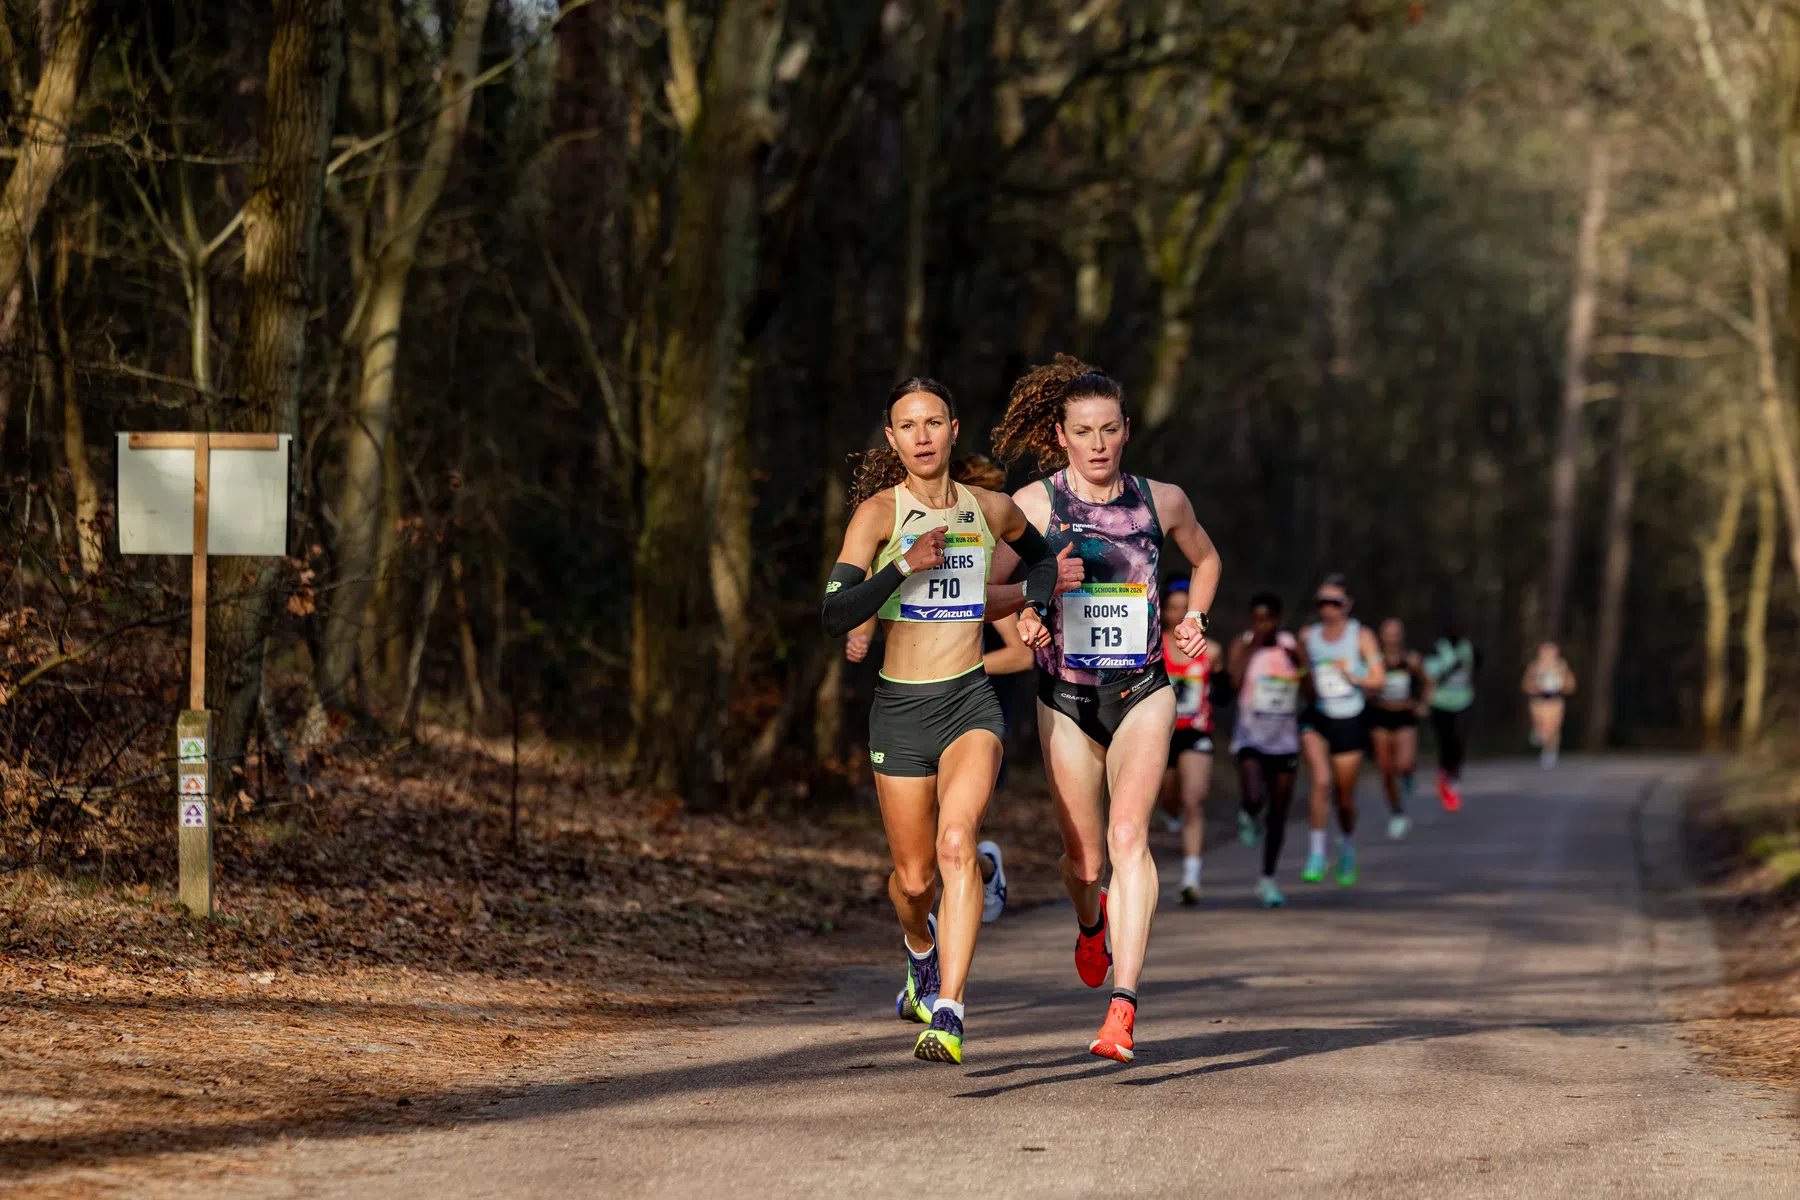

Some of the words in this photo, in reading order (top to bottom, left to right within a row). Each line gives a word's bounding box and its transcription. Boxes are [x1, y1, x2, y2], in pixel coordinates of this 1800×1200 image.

[928, 577, 961, 599] F10
[1084, 605, 1129, 618] ROOMS
[1091, 626, 1122, 647] F13
[1060, 692, 1085, 702] CRAFT
